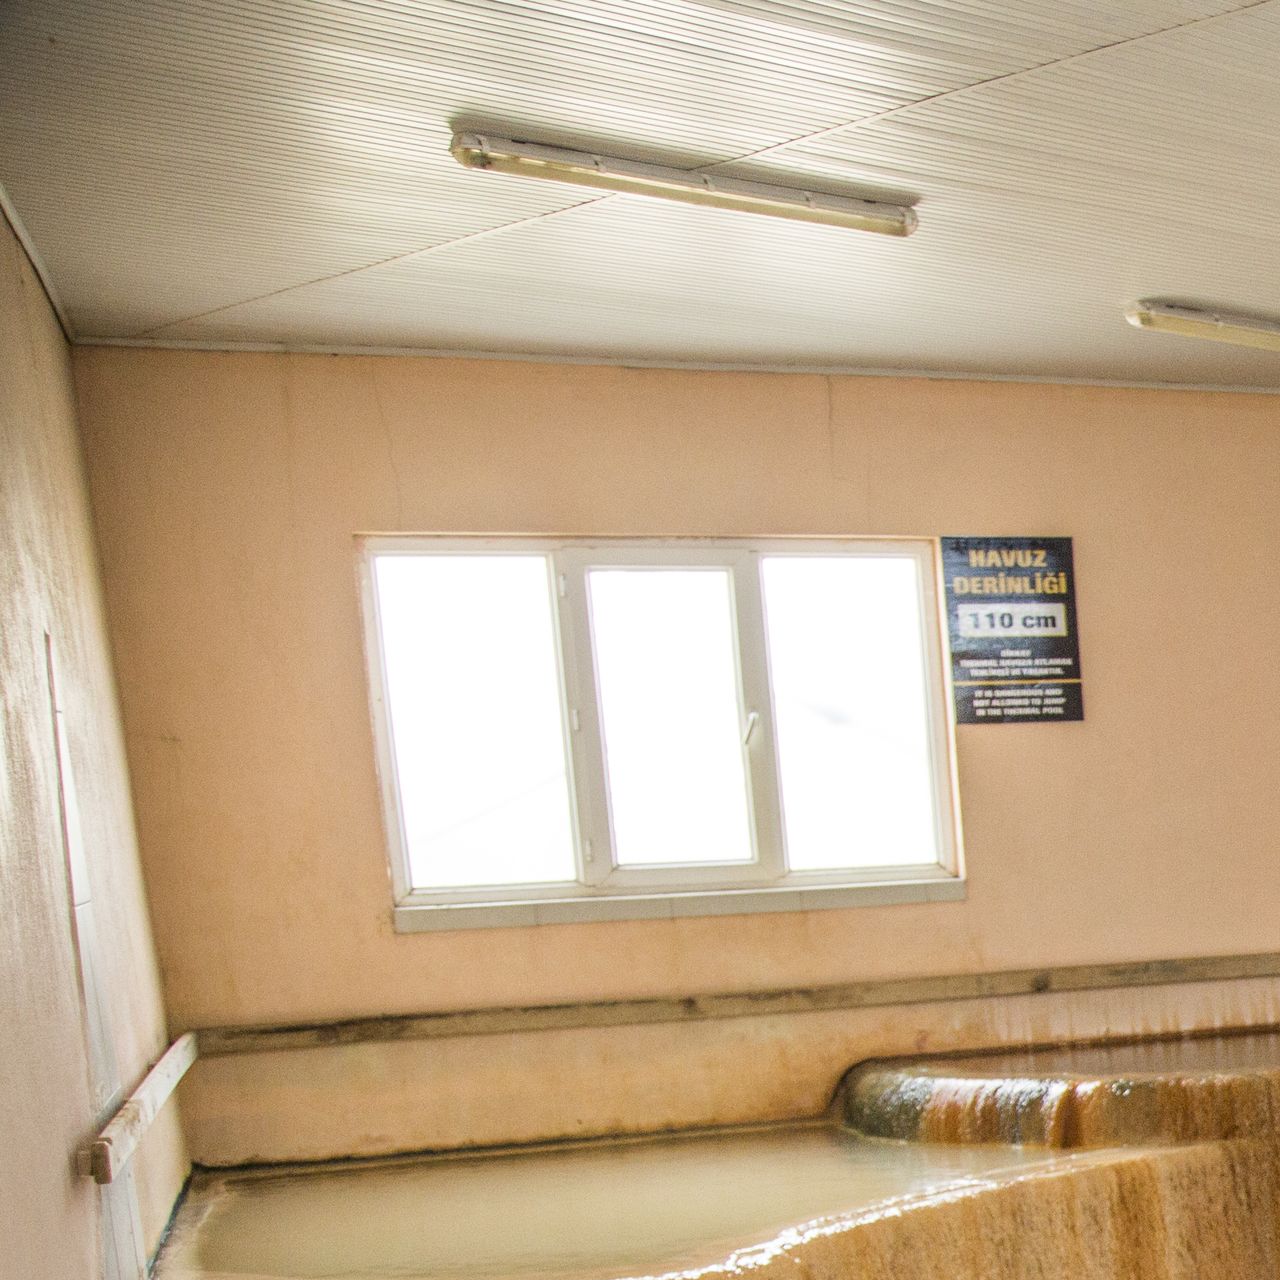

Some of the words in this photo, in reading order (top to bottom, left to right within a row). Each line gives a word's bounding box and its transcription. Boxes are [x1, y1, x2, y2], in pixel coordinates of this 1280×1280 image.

[968, 550, 1047, 568] HAVUZ
[953, 572, 1068, 594] DERİNLİĞİ
[969, 612, 1013, 629] 110
[1022, 614, 1056, 628] cm
